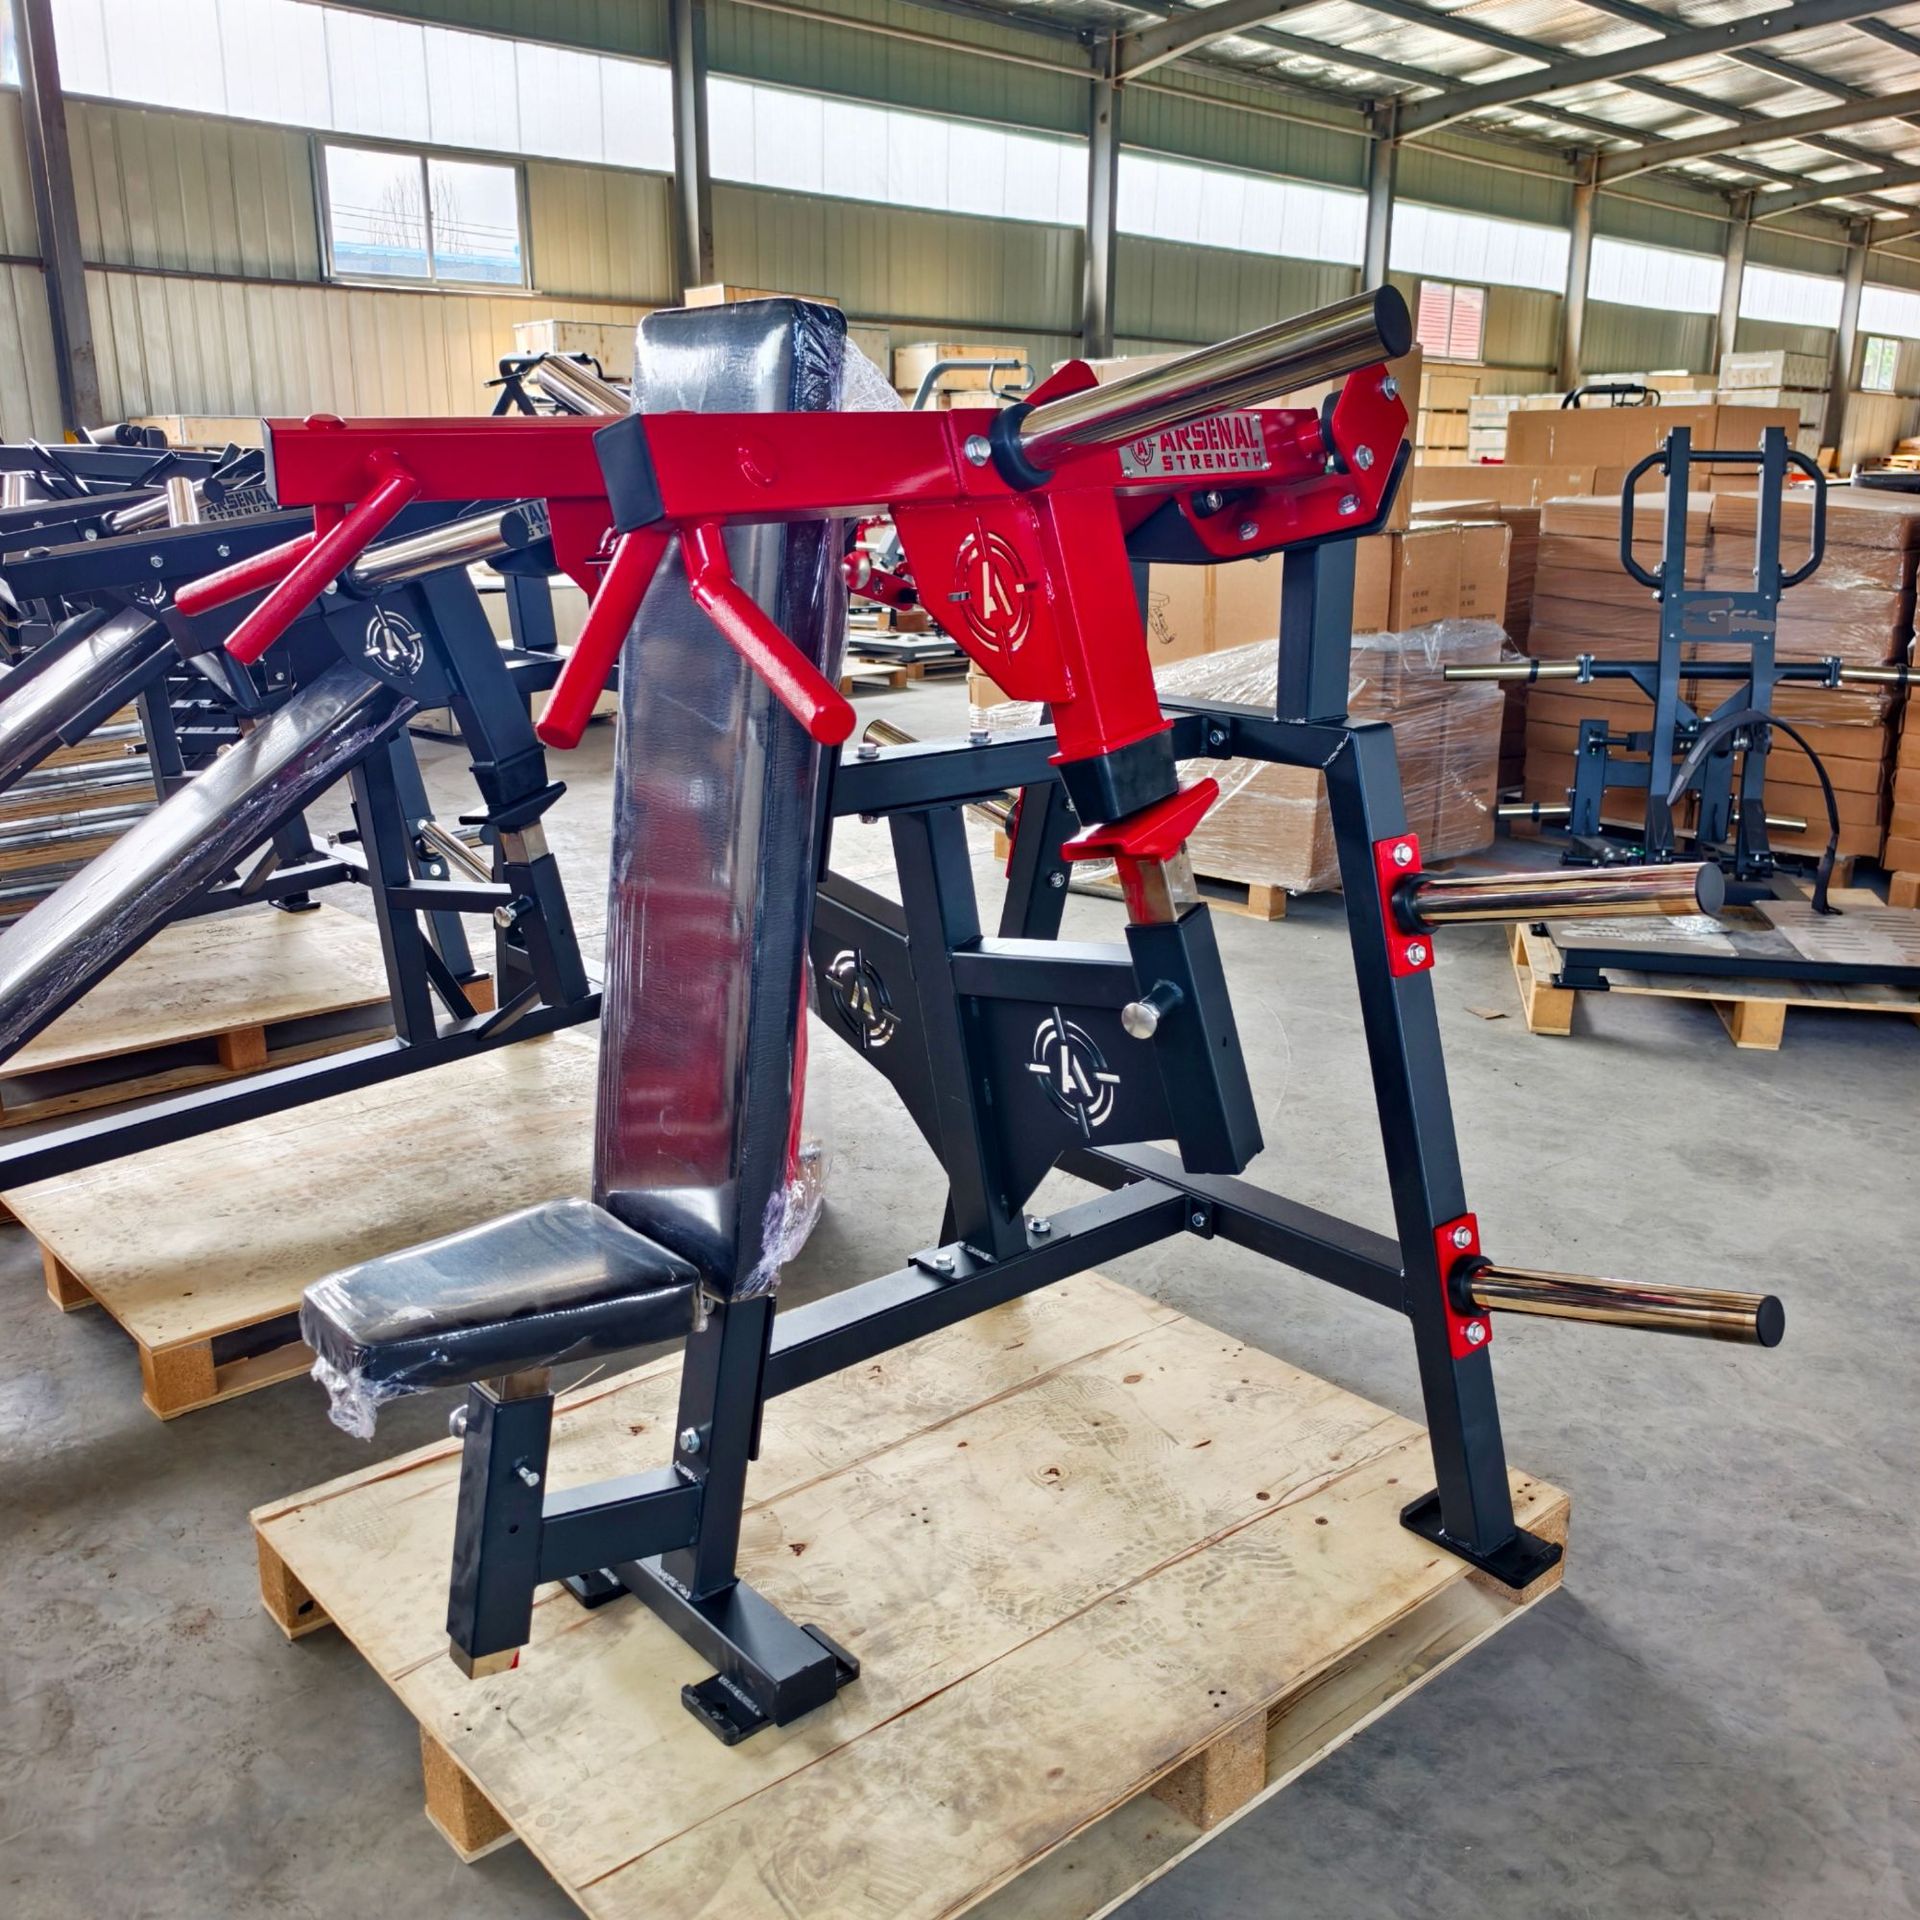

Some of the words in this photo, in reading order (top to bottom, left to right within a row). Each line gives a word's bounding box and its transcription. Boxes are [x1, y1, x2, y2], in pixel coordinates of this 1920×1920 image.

[1160, 416, 1259, 452] ARSENAL
[1161, 451, 1263, 471] STRENGTH
[208, 502, 279, 521] STRENGTH
